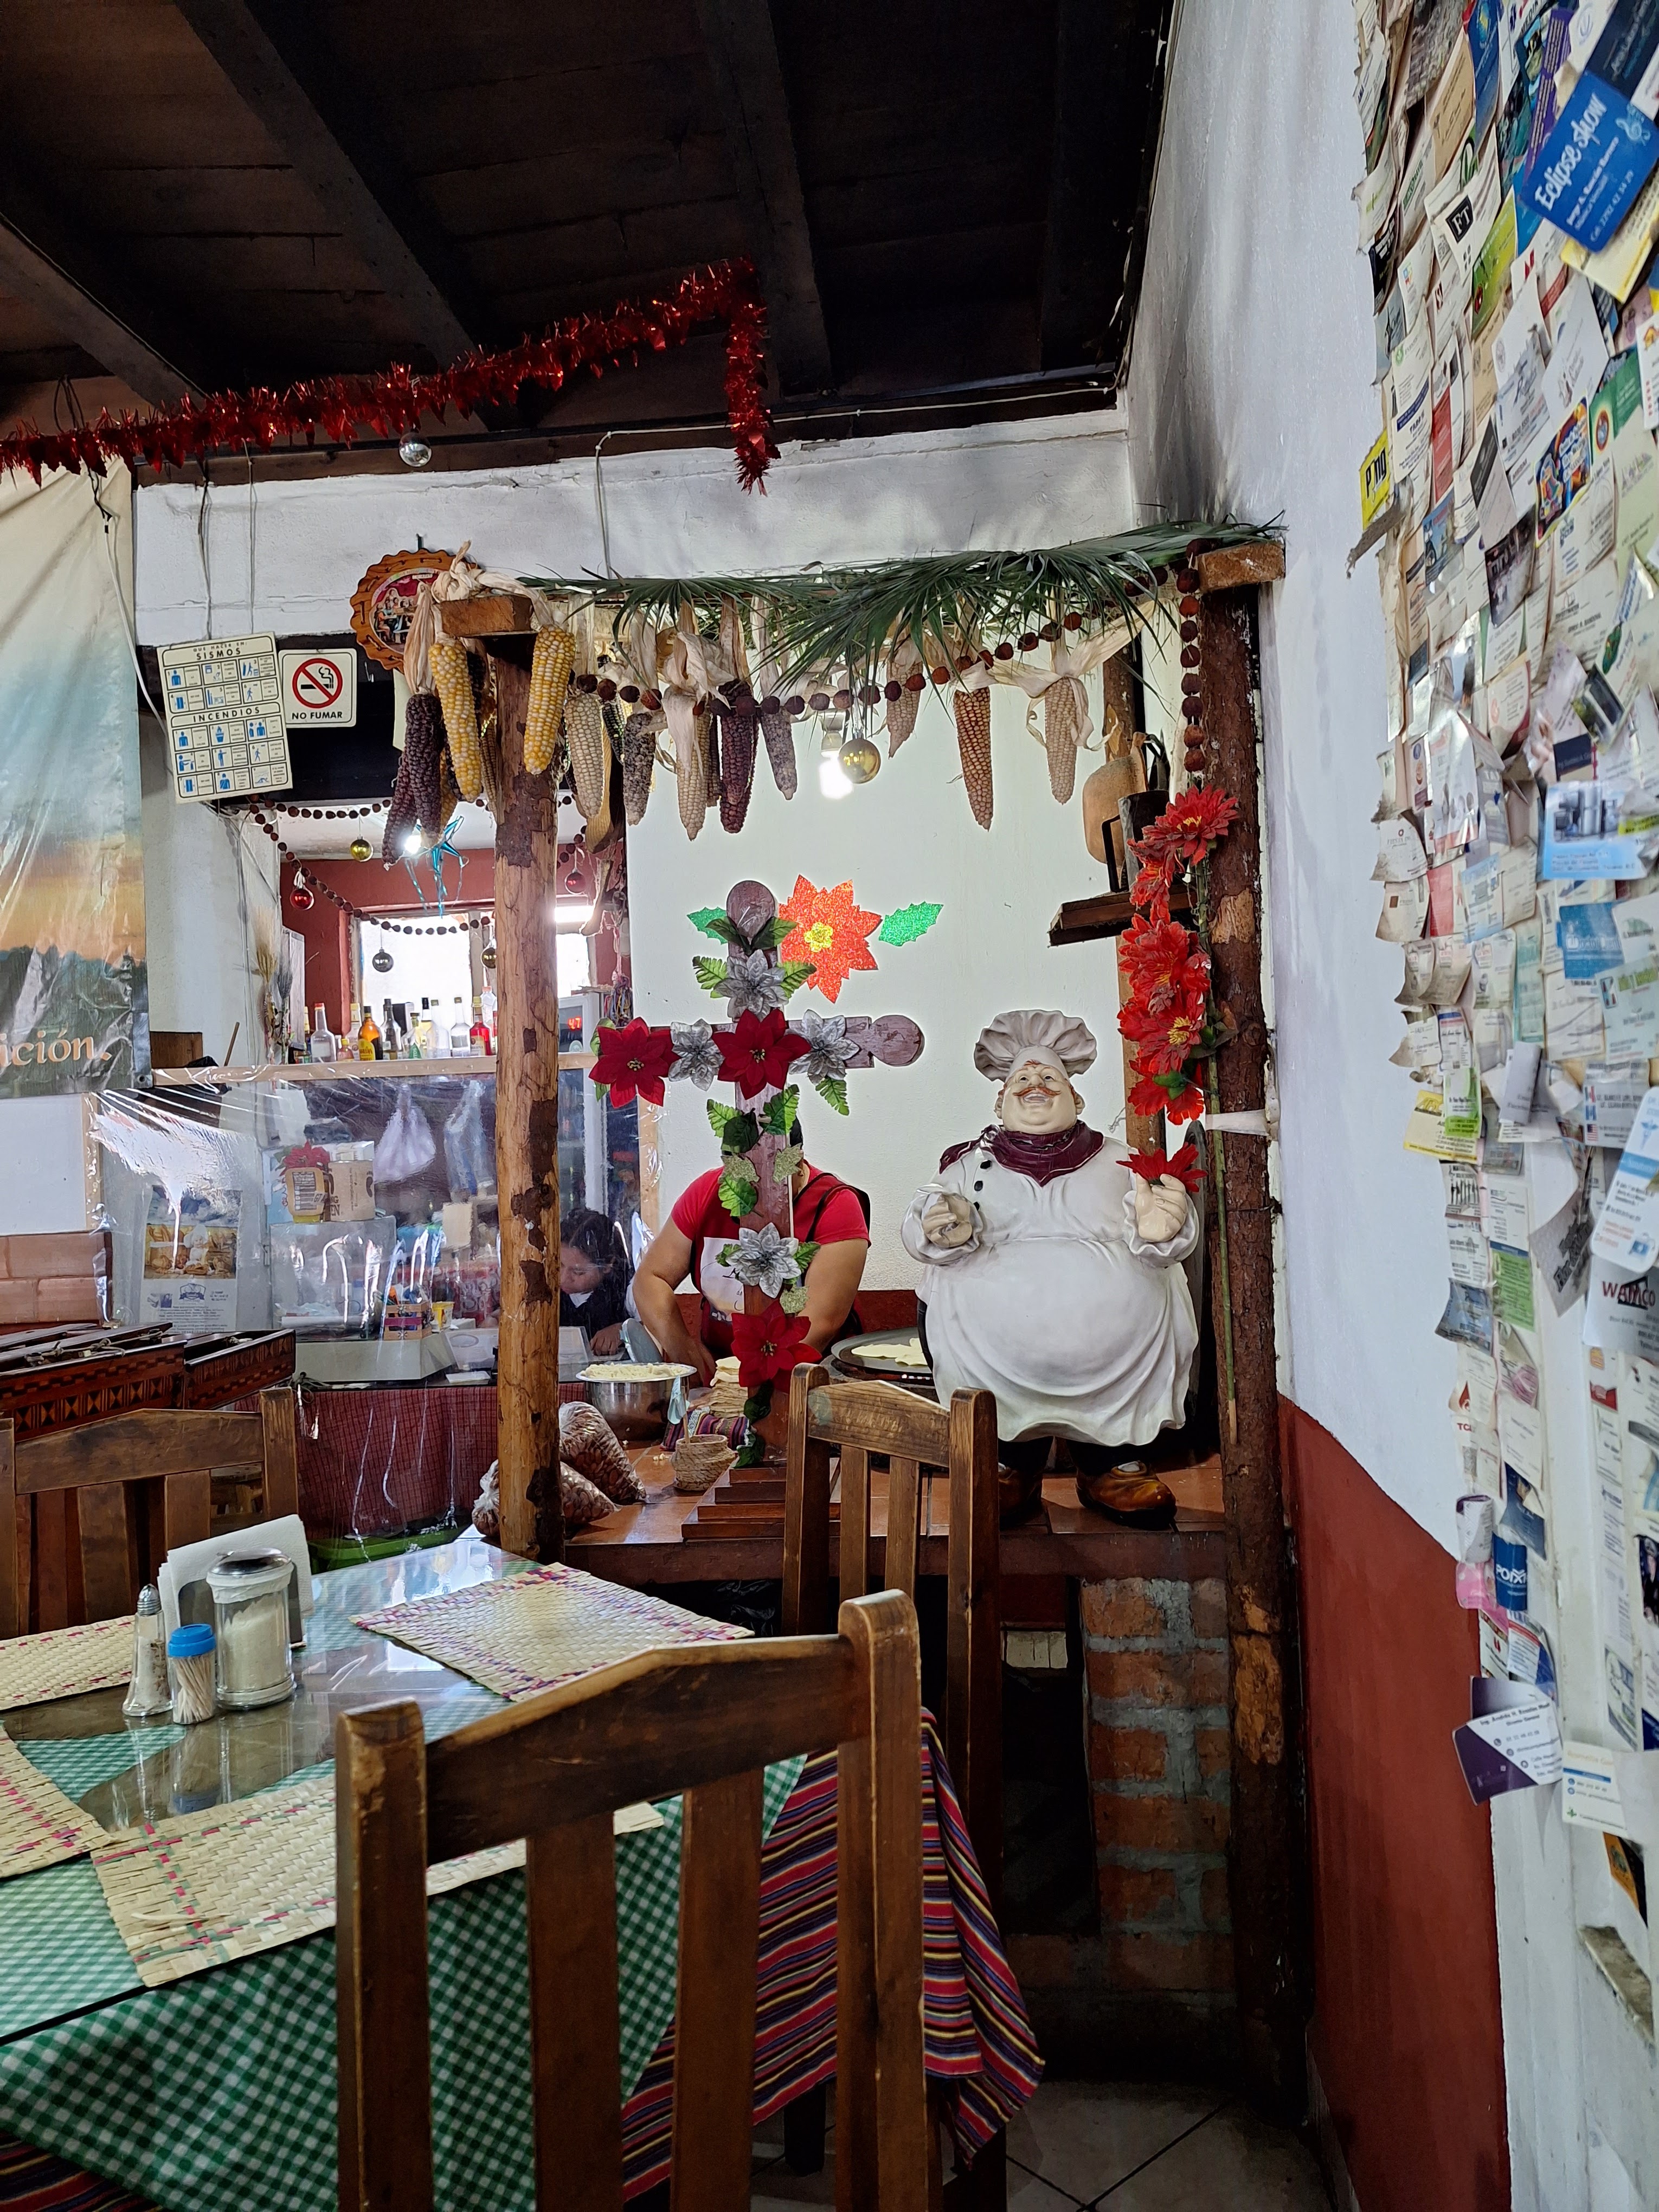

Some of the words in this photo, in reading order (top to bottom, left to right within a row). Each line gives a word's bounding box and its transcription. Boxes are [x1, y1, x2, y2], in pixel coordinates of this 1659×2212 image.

[1534, 145, 1582, 212] Eclipse
[1571, 92, 1607, 149] show
[1451, 205, 1470, 235] FT
[196, 647, 241, 660] SISMOS
[210, 642, 232, 650] HACER
[193, 706, 260, 722] INCENDIOS
